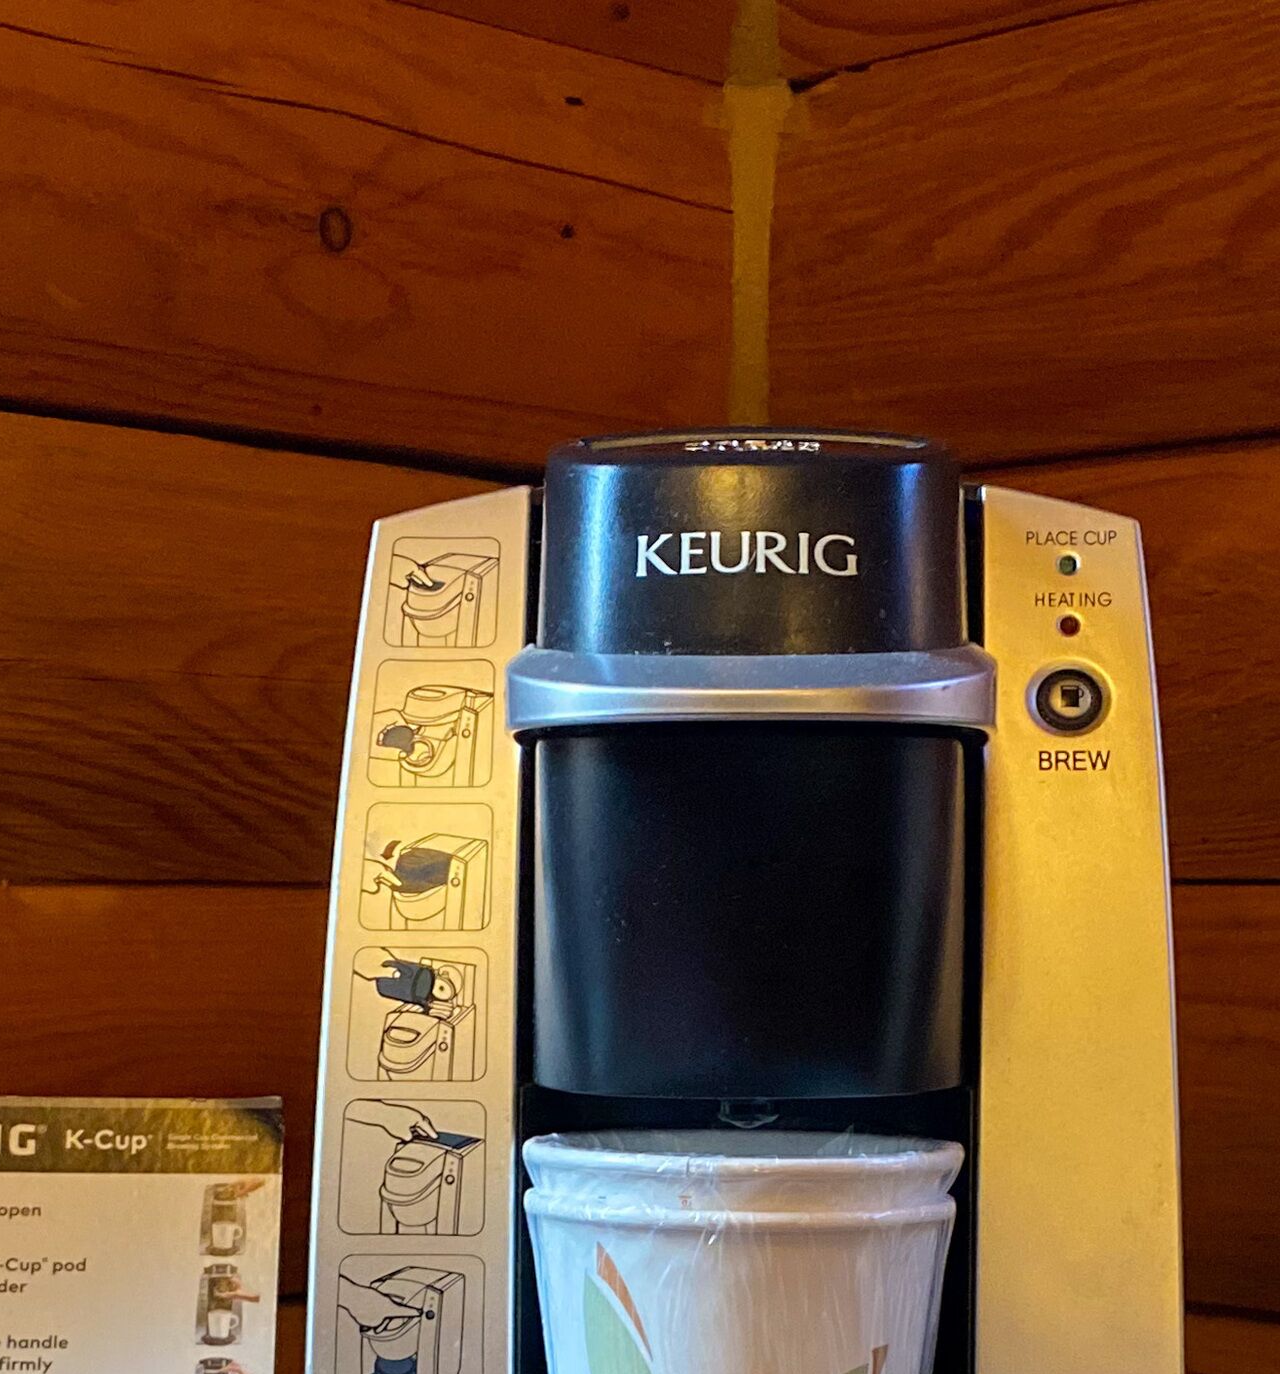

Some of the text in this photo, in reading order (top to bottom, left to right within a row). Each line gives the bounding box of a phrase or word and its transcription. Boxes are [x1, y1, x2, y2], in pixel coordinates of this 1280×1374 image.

[1025, 530, 1117, 546] PLACE CUP
[635, 531, 858, 577] KEURIG
[1034, 592, 1112, 607] HEATING
[1038, 750, 1110, 771] BREW
[52, 1258, 87, 1275] pod
[6, 1335, 69, 1350] handle
